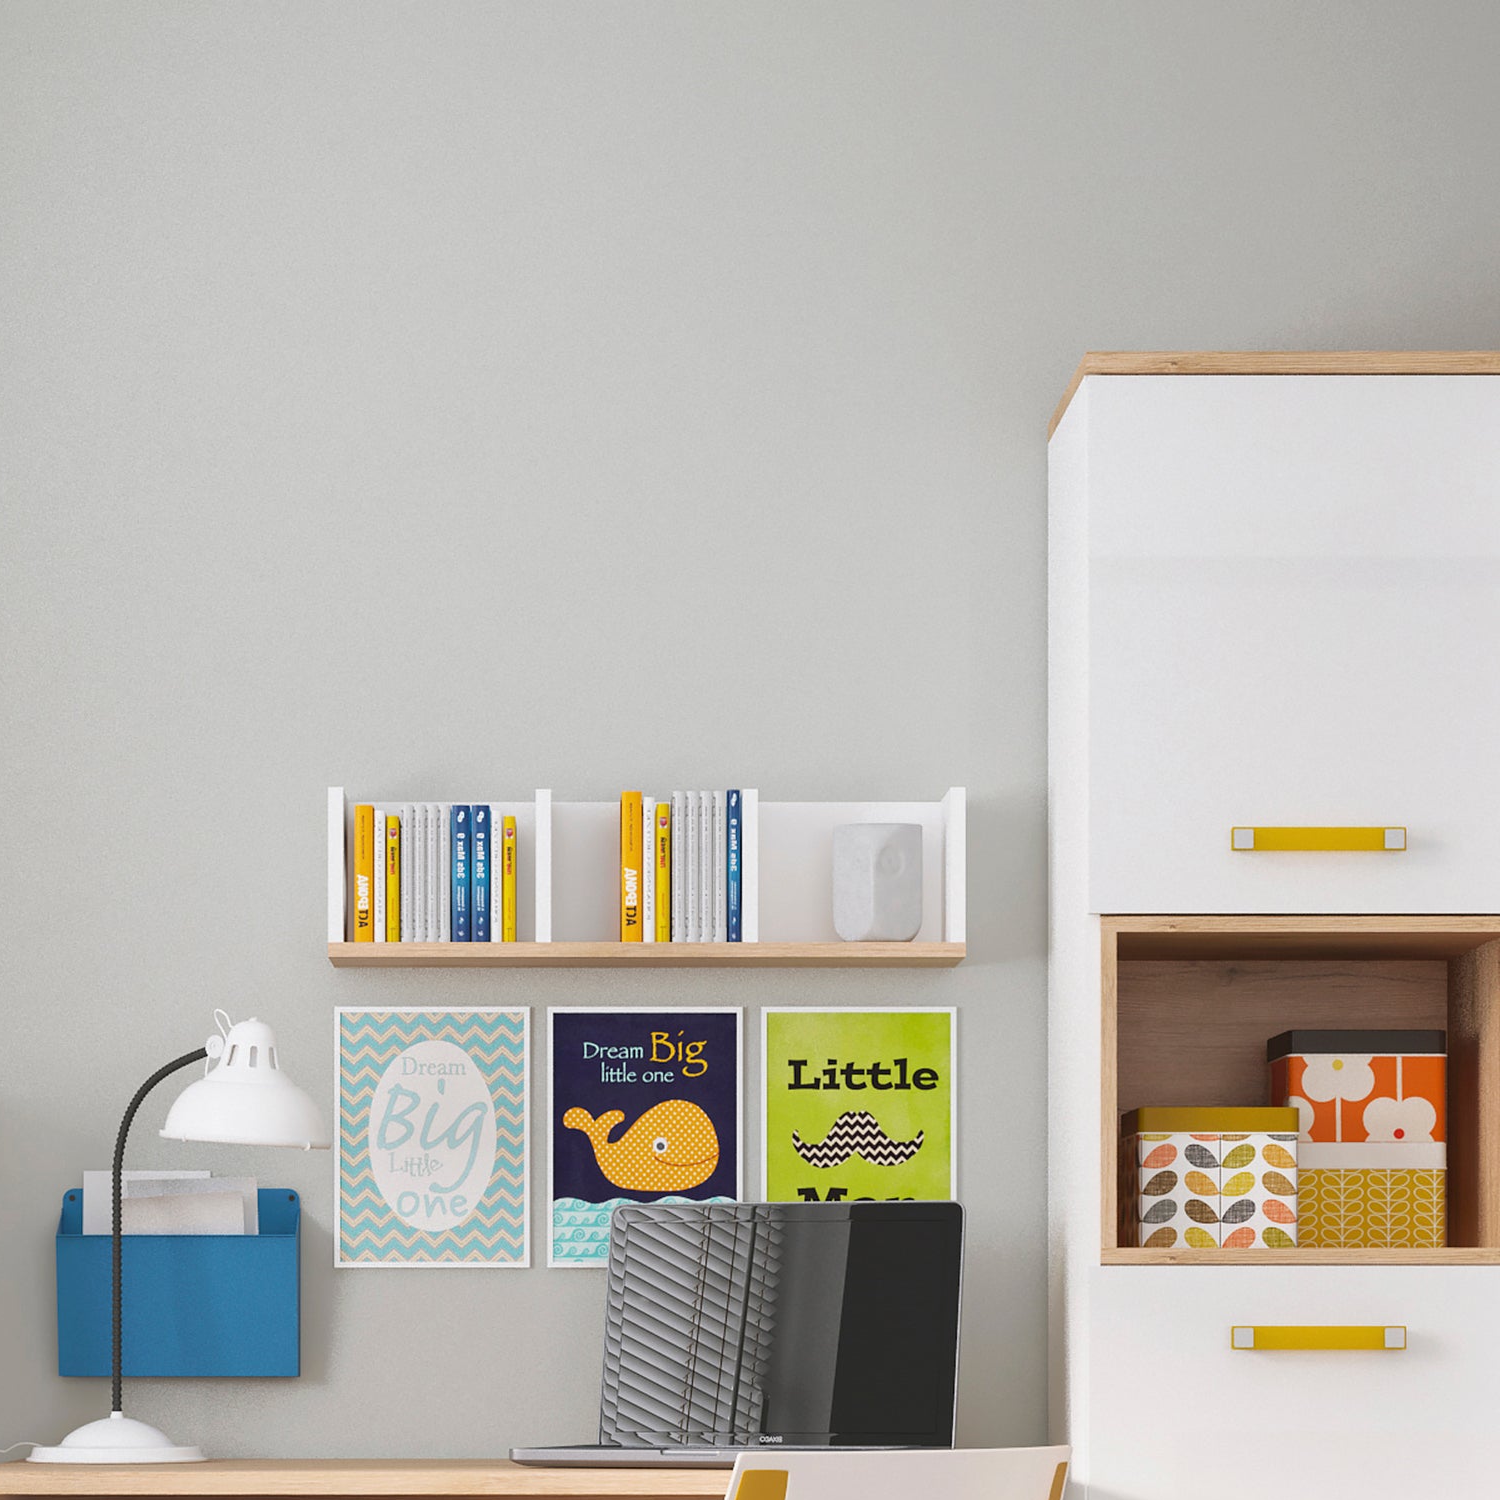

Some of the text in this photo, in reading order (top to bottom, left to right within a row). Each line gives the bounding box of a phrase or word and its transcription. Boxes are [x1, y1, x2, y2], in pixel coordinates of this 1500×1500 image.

[402, 1056, 467, 1076] Dream
[583, 1030, 708, 1077] Dream Big
[601, 1061, 675, 1083] little one
[788, 1058, 939, 1090] Little
[376, 1078, 488, 1193] Big
[388, 1152, 443, 1177] Little
